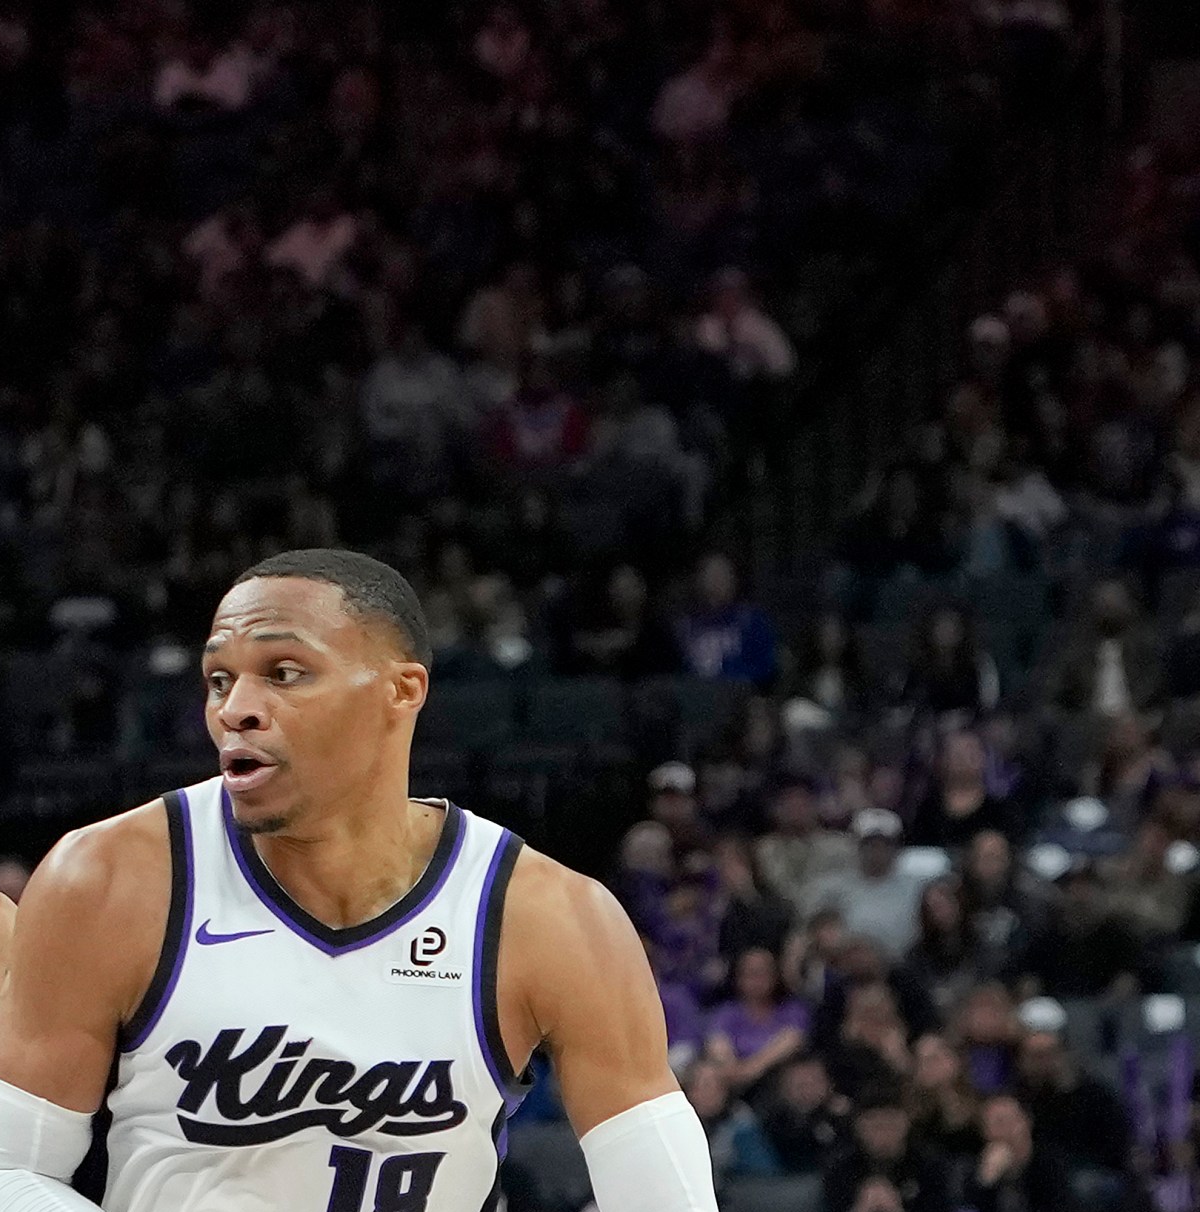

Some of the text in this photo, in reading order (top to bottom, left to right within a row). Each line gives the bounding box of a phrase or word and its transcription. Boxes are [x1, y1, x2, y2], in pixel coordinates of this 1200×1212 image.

[391, 968, 462, 980] PHOONG LAW
[164, 1024, 469, 1148] Kings
